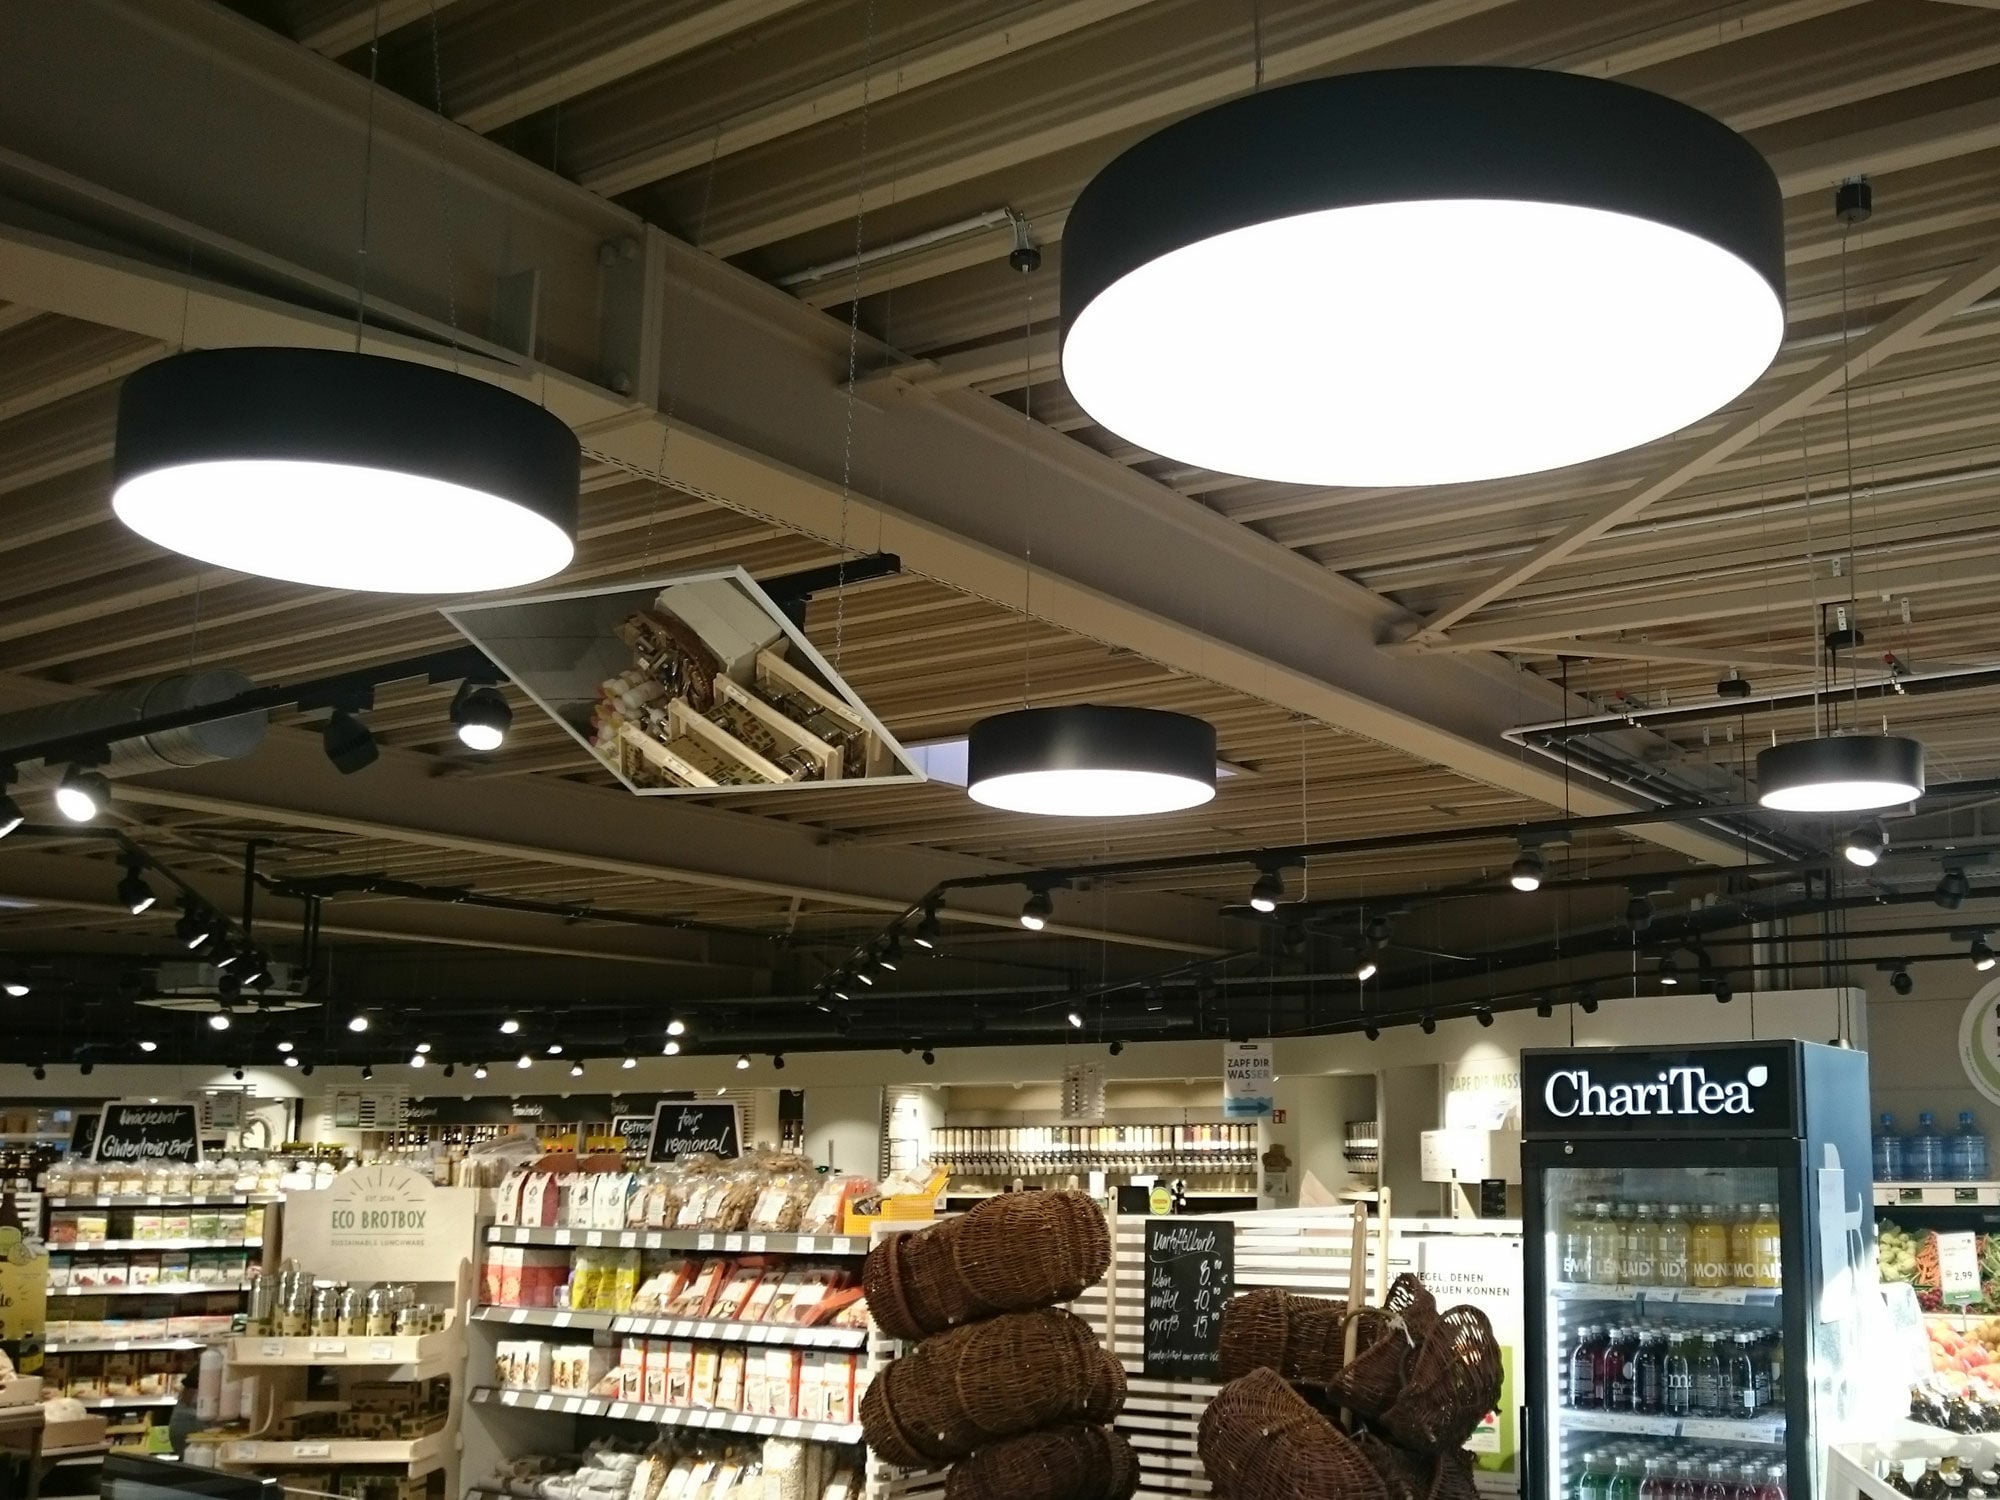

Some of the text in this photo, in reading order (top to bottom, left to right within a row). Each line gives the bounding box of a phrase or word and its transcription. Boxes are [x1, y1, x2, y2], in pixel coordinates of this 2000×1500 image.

[1227, 1058, 1270, 1068] ZAPF DIR
[1227, 1069, 1270, 1080] WASSER
[1545, 1067, 1754, 1117] ChariTea
[664, 1126, 730, 1155] regional
[331, 1210, 426, 1229] ECO BROTBOX
